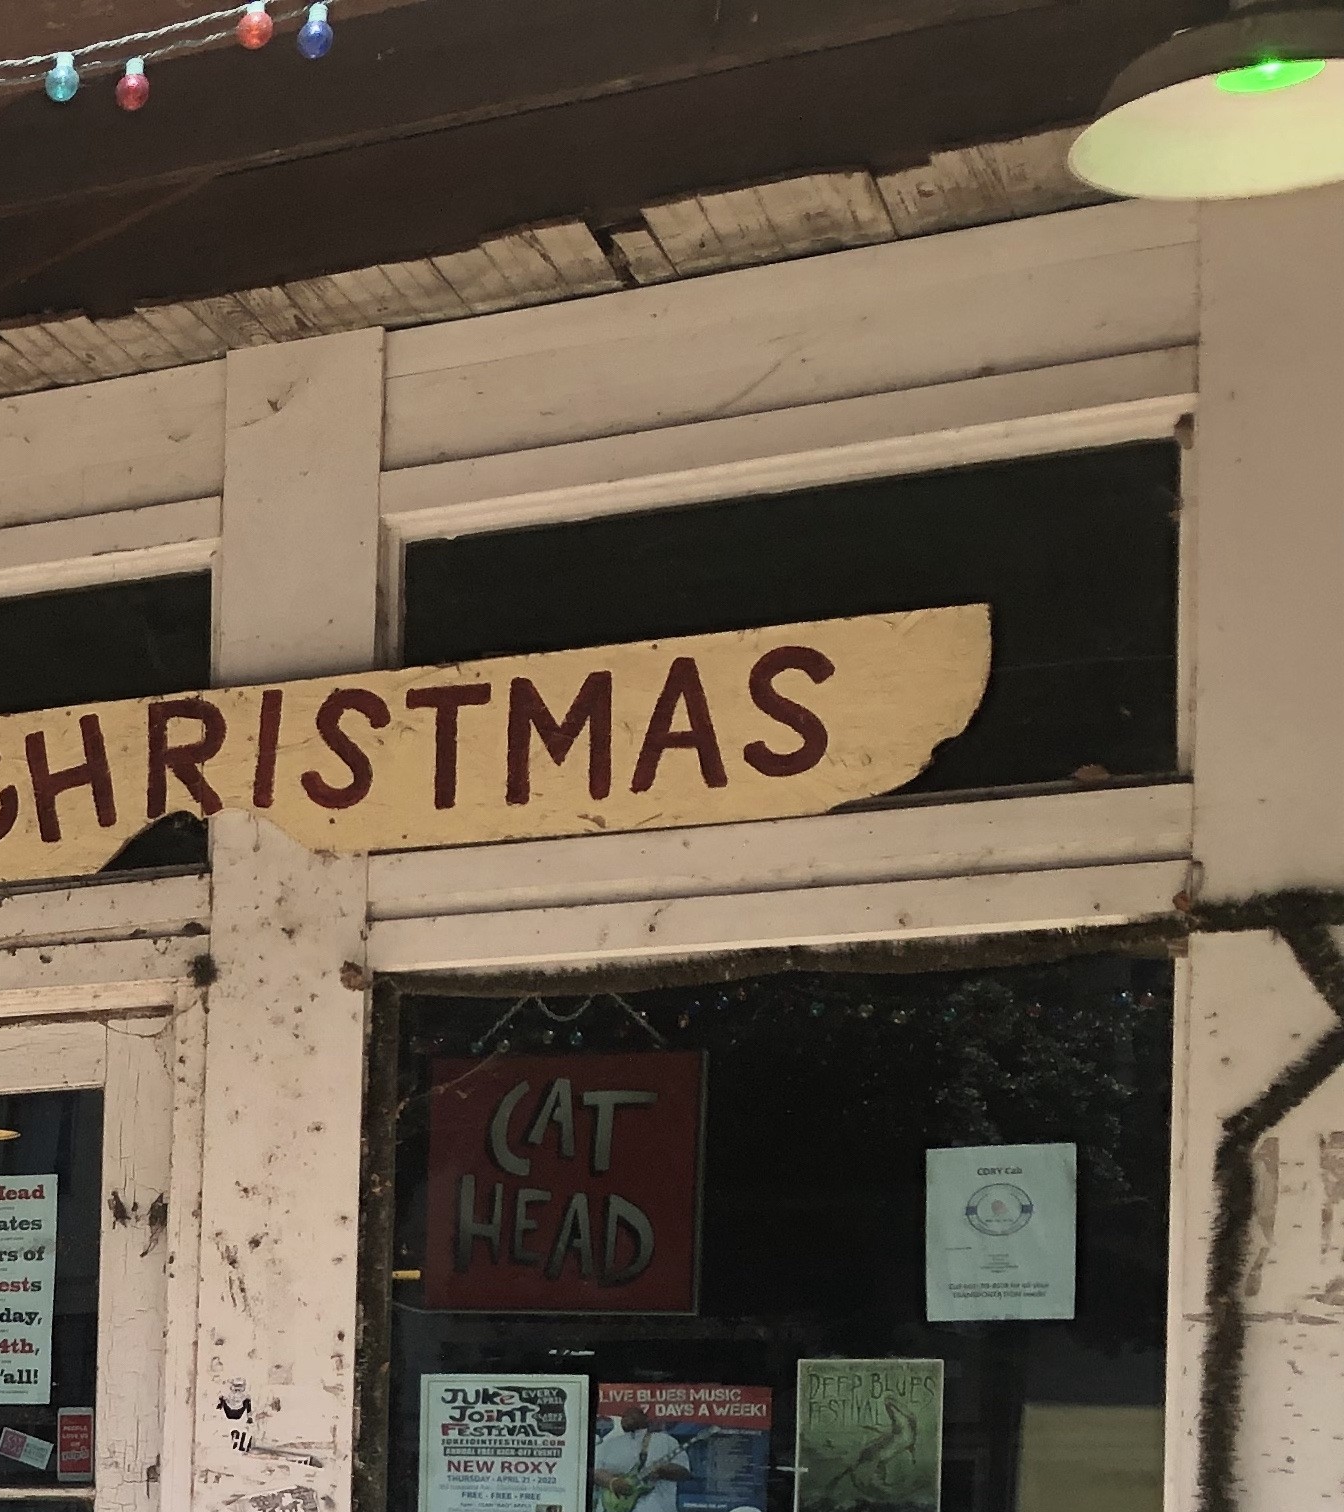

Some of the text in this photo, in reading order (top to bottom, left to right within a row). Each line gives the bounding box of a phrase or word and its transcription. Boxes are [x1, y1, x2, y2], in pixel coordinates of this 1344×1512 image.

[490, 1077, 659, 1176] CAT
[454, 1174, 655, 1287] HEAD
[23, 1246, 45, 1261] of
[599, 1389, 742, 1402] LIVE BLUES MUSIC
[655, 1404, 695, 1416] DAYS
[698, 1404, 709, 1416] A
[713, 1404, 767, 1417] WEEK!
[441, 1423, 548, 1438] FESTIVAL
[447, 1460, 558, 1474] NEW ROXY
